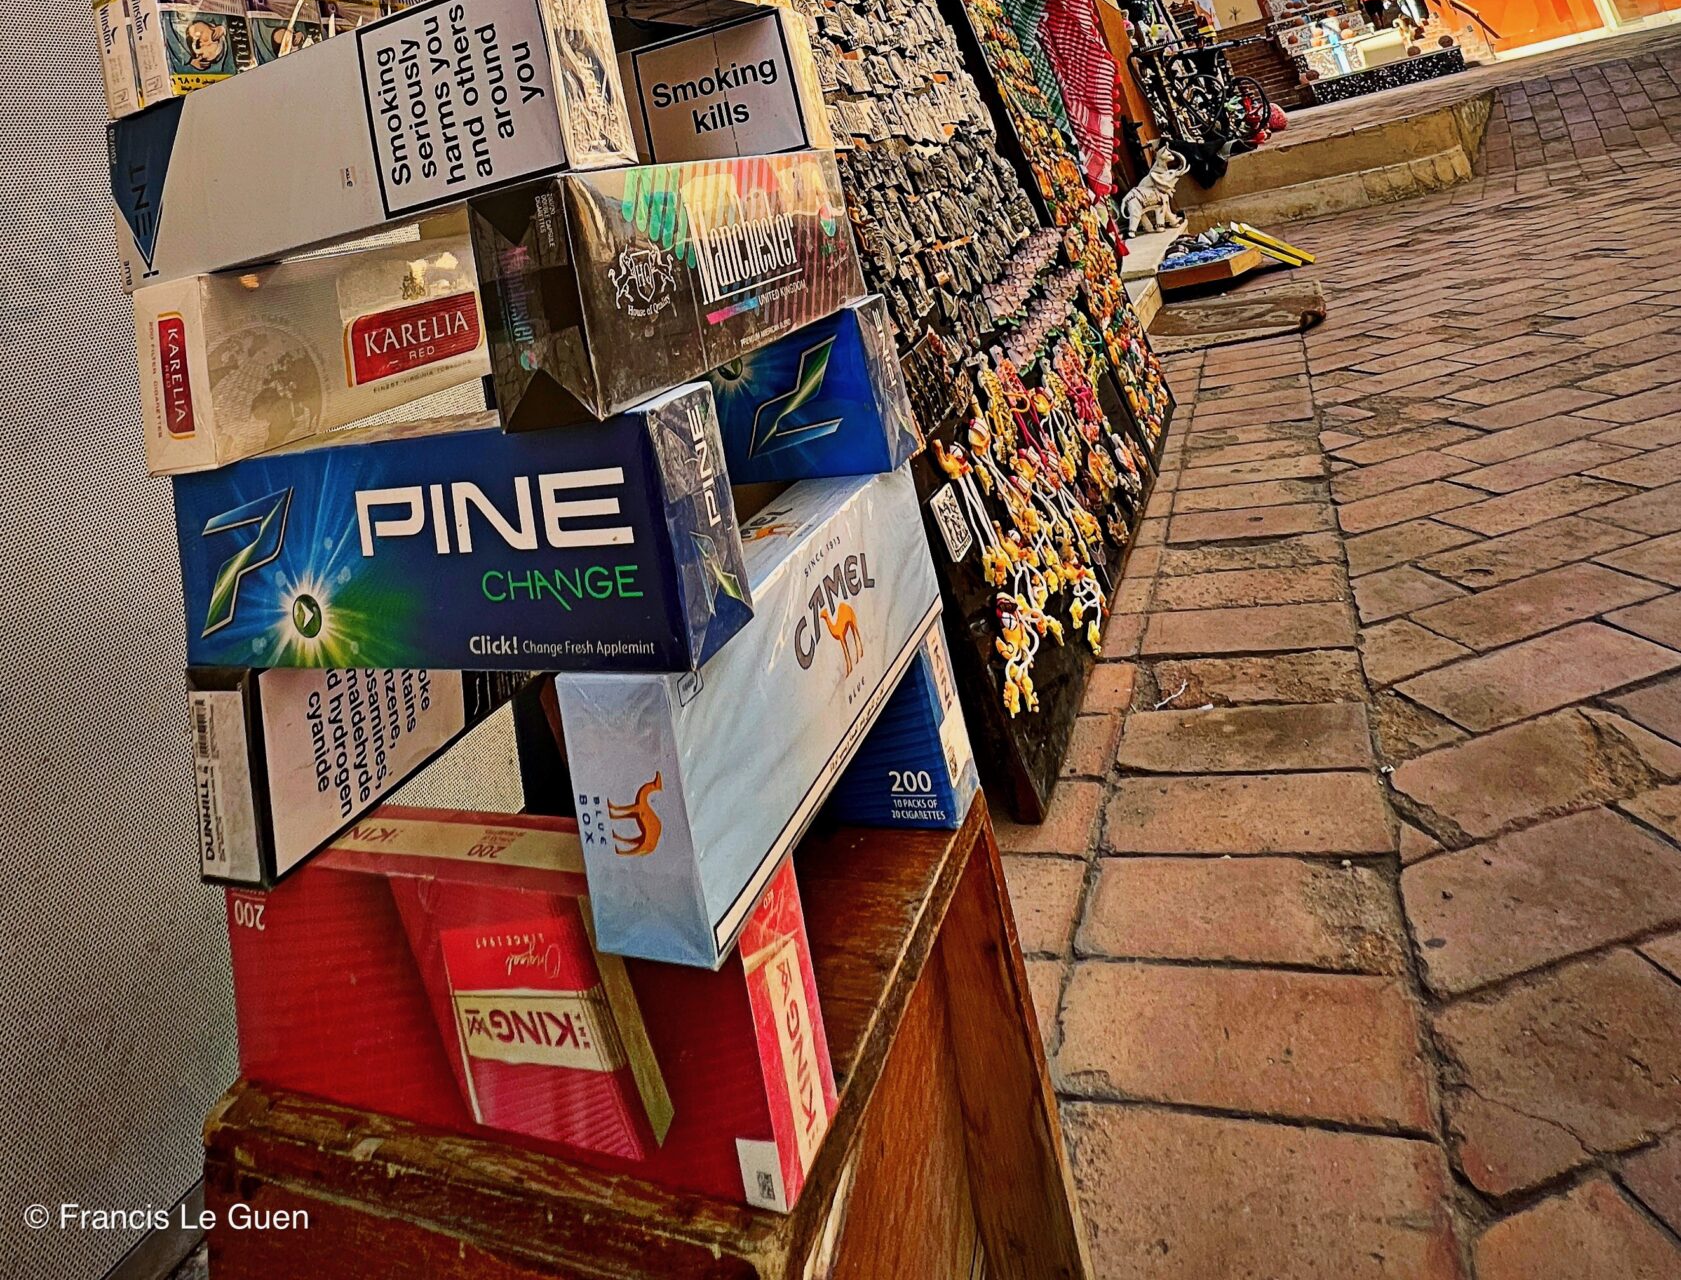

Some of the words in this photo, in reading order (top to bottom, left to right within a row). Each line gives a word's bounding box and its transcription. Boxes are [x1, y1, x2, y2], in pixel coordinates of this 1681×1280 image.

[424, 15, 451, 76] you
[449, 3, 480, 107] others
[475, 22, 515, 140] around
[511, 40, 545, 105] you
[652, 58, 778, 109] Smoking
[377, 46, 412, 186] Smoking
[399, 38, 437, 179] seriously
[435, 81, 467, 186] harms
[693, 102, 750, 134] kills
[463, 115, 494, 178] and
[534, 195, 546, 234] CIGARETTES
[546, 219, 556, 249] CAPSULE
[123, 260, 133, 286] BLUE
[684, 192, 800, 306] Manchester
[627, 305, 646, 318] House
[646, 304, 654, 317] of
[653, 295, 672, 315] Quality
[758, 287, 780, 306] UNITED
[778, 278, 809, 300] KINGDOM
[364, 310, 469, 358] KARELIA
[409, 345, 435, 361] RED
[872, 308, 897, 388] PINE
[164, 364, 172, 389] RED
[167, 328, 187, 424] KARELIA
[373, 381, 400, 394] FINEST
[153, 380, 163, 439] CIGARETTES
[686, 404, 723, 528] PINE
[355, 467, 635, 557] PINE
[804, 551, 825, 578] SINCE
[825, 535, 842, 553] 1913
[482, 565, 644, 611] CHANGE
[794, 552, 876, 671] CAMEL
[469, 636, 518, 656] Click!
[523, 639, 563, 656] Change
[565, 639, 594, 655] Fresh
[596, 639, 656, 657] Applemint
[384, 669, 401, 749] nzene,
[417, 669, 431, 712] oke
[847, 676, 867, 706] BLUE
[307, 691, 331, 793] cyanide
[328, 692, 354, 819] hydrogen
[346, 669, 371, 803] maldehyde
[888, 770, 932, 793] 200
[893, 798, 902, 808] 10
[902, 798, 926, 809] PACKS
[927, 798, 938, 808] OF
[200, 781, 216, 862] DUNHILL
[347, 825, 394, 844] KIN
[578, 793, 595, 845] BOX
[592, 796, 608, 846] BLUE
[901, 809, 946, 821] CIGARETTES
[467, 843, 506, 860] 200
[234, 899, 266, 932] 200
[504, 942, 561, 980] Original
[489, 1009, 582, 1049] KING
[786, 1000, 817, 1136] KING
